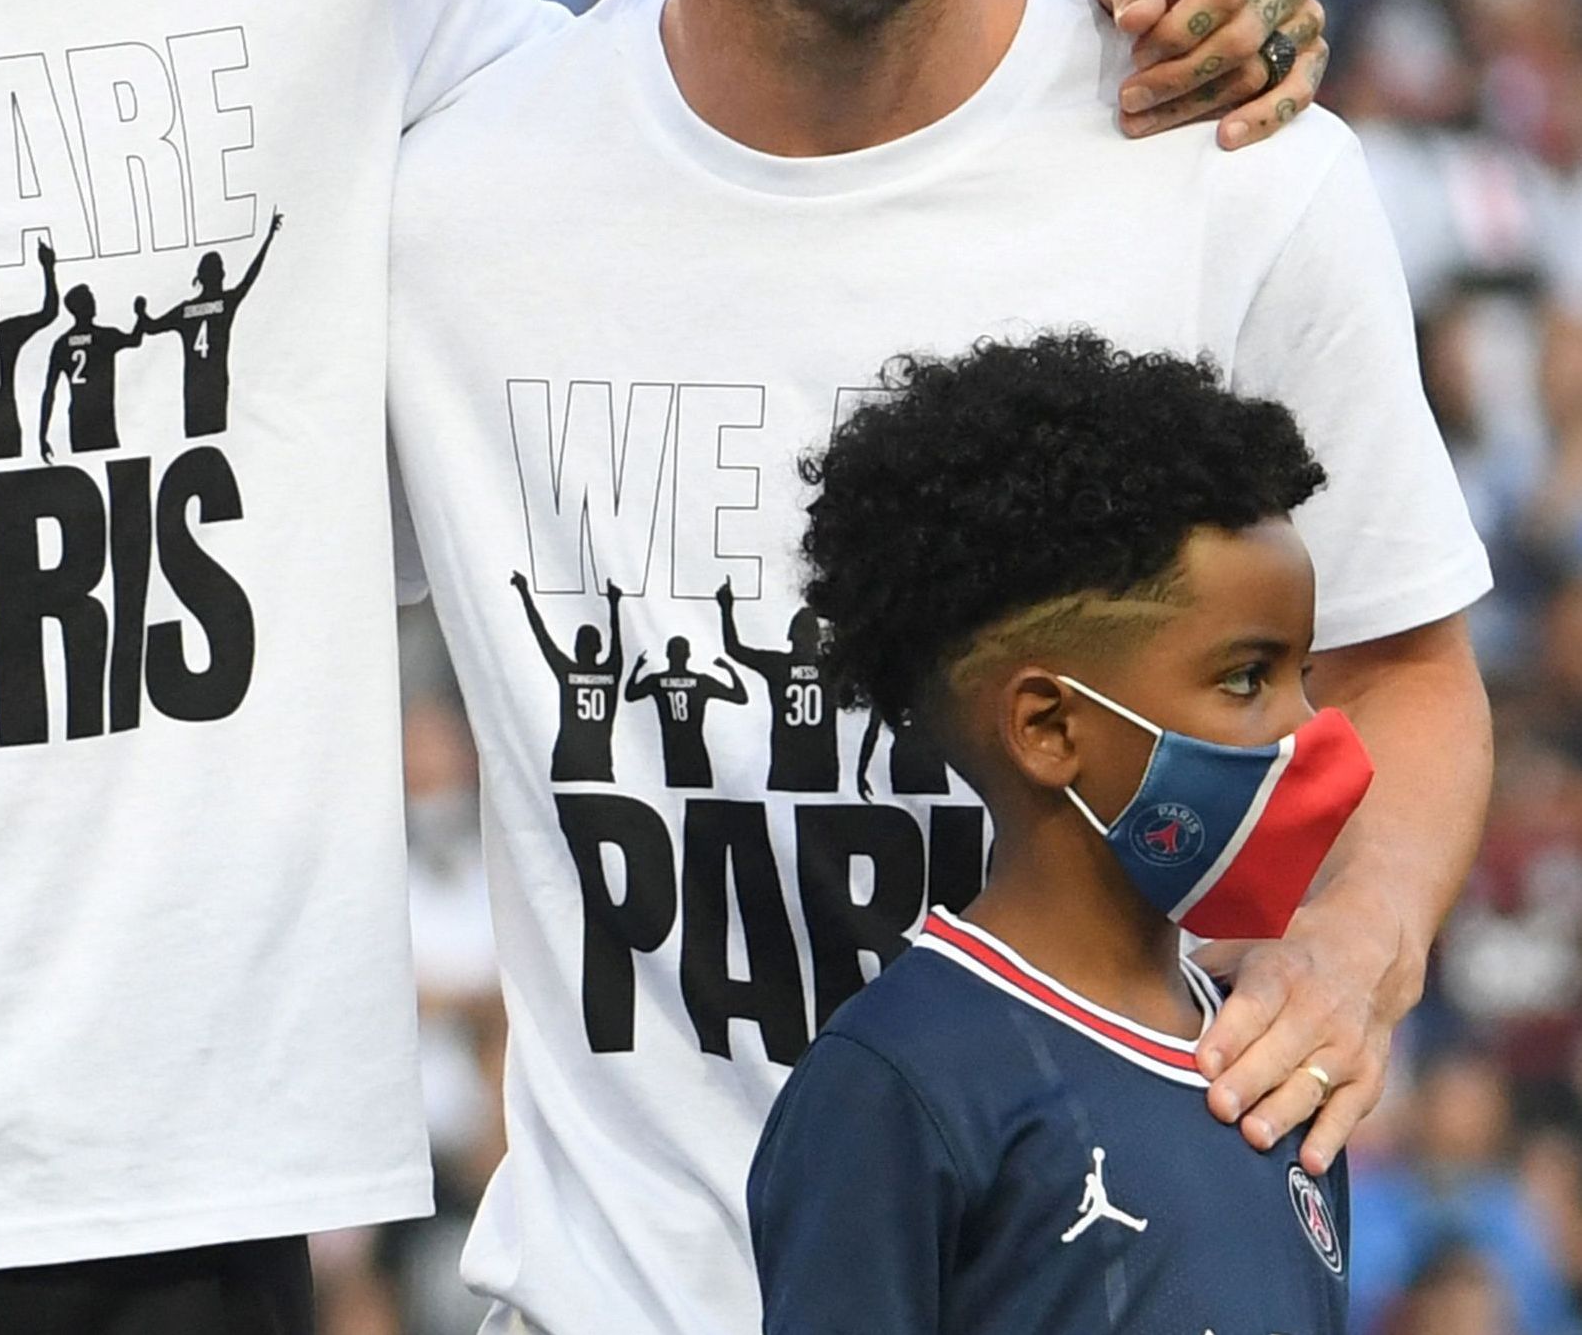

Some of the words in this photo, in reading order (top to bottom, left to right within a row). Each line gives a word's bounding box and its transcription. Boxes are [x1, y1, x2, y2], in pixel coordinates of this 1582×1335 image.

[193, 319, 209, 358] 4
[71, 349, 87, 384] 2
[506, 379, 766, 600] WE
[576, 688, 606, 721] 50
[667, 690, 688, 722] 18
[785, 684, 823, 726] 30
[1158, 806, 1200, 834] PARIS
[552, 792, 993, 1066] PAR
